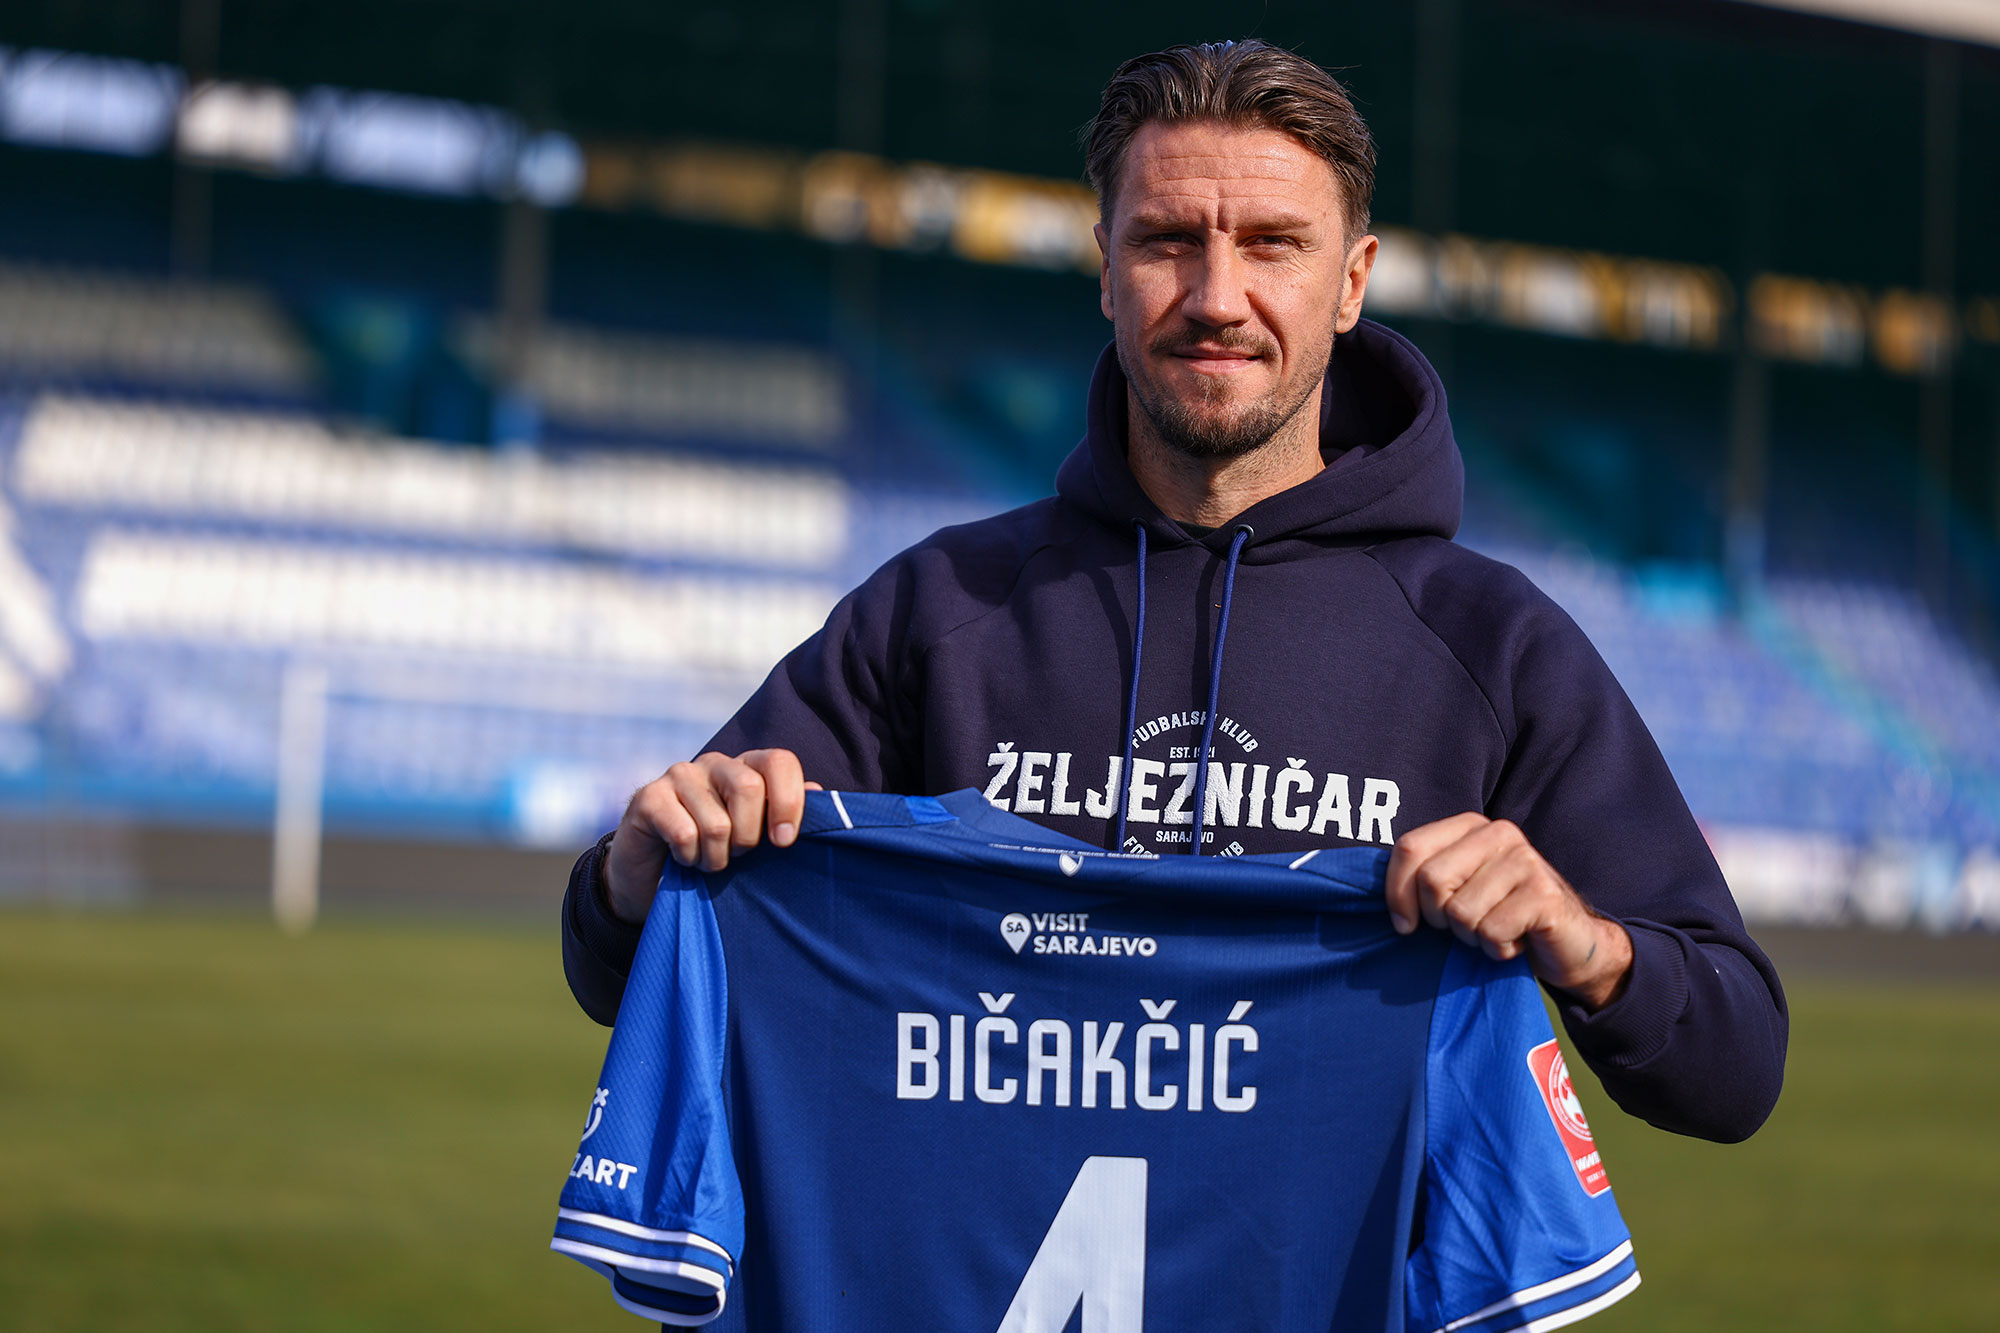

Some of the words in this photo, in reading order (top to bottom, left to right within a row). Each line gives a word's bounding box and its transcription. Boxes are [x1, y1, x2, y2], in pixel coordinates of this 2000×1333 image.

[1218, 717, 1259, 753] KLUB
[1169, 746, 1191, 758] EST.
[982, 742, 1401, 846] ŽELJEZNIČAR
[1155, 830, 1214, 843] SARAJVO
[1006, 921, 1025, 933] SA
[1031, 912, 1089, 932] VISIT
[1033, 935, 1158, 957] SARAJEVO
[896, 992, 1260, 1112] BIČAKČIĆ
[996, 1155, 1148, 1333] 4
